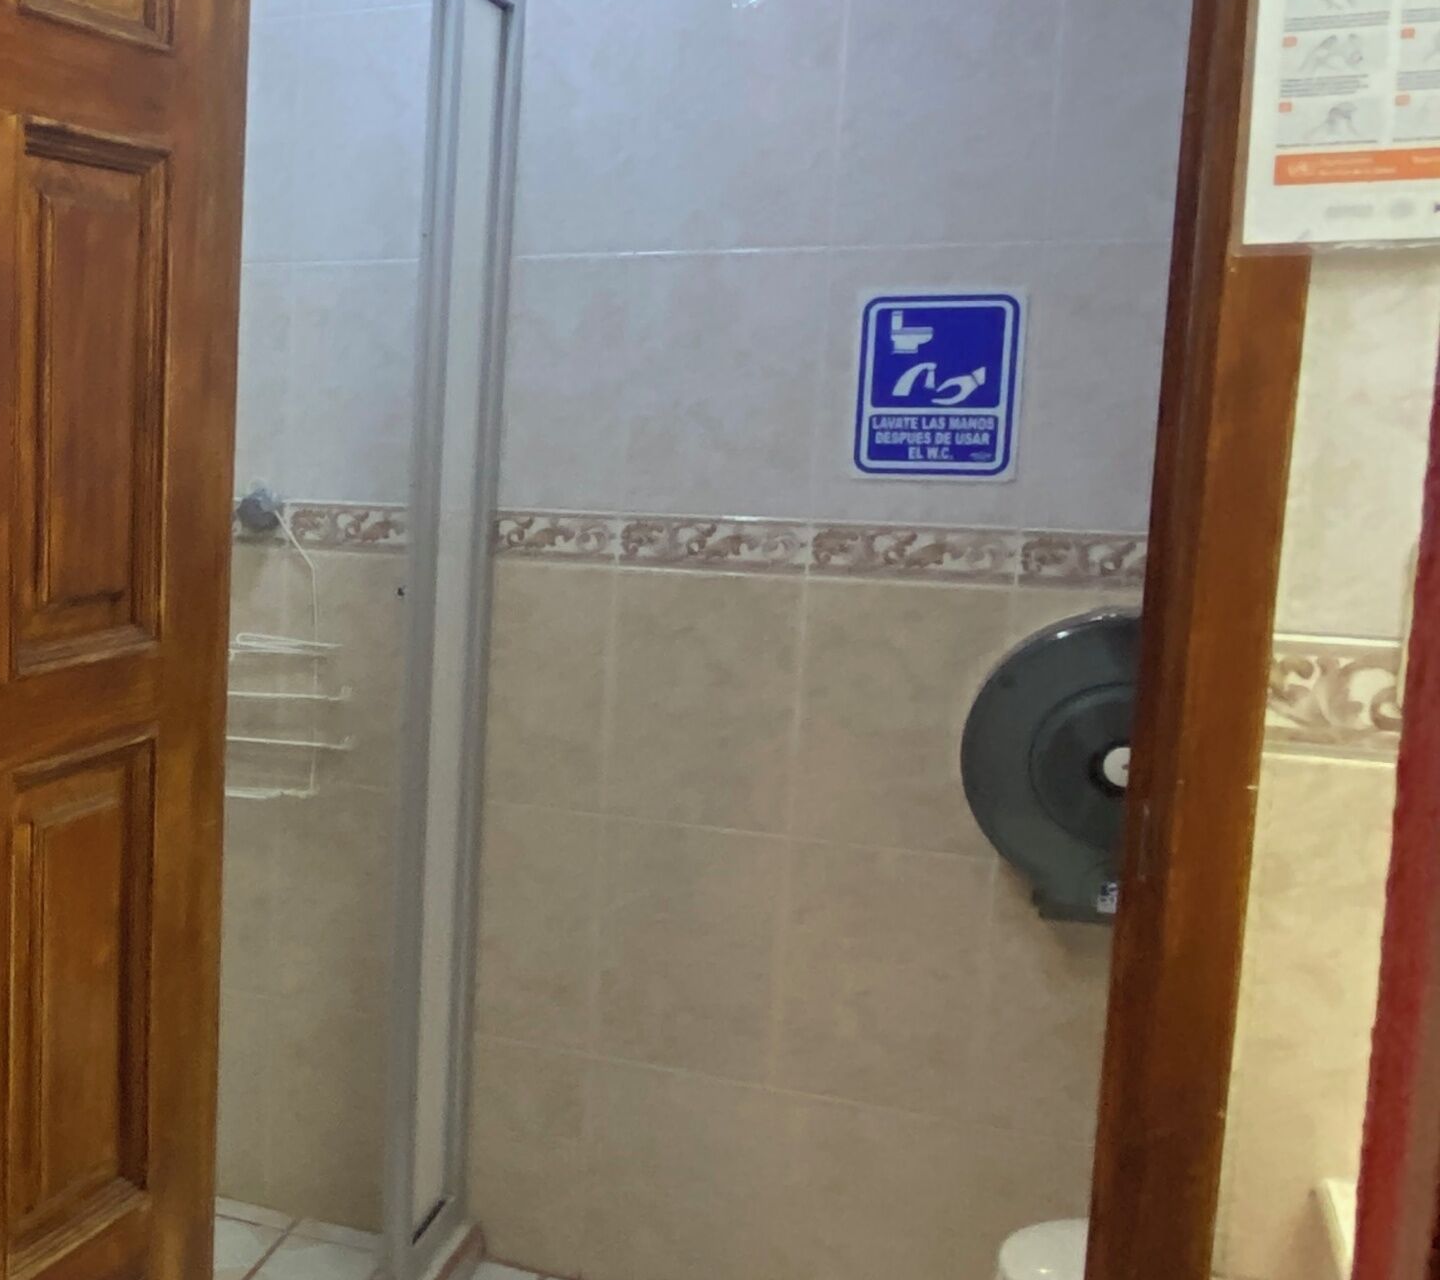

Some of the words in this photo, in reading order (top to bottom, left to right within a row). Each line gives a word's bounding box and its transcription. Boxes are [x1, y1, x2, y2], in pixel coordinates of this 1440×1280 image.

[872, 416, 919, 430] LAVATE
[922, 416, 946, 430] LAS
[948, 416, 994, 431] MANOS
[875, 431, 932, 445] DESPUES
[935, 431, 952, 445] DE
[955, 432, 990, 446] USAR
[908, 446, 923, 460] EL
[926, 446, 954, 461] W.C.
